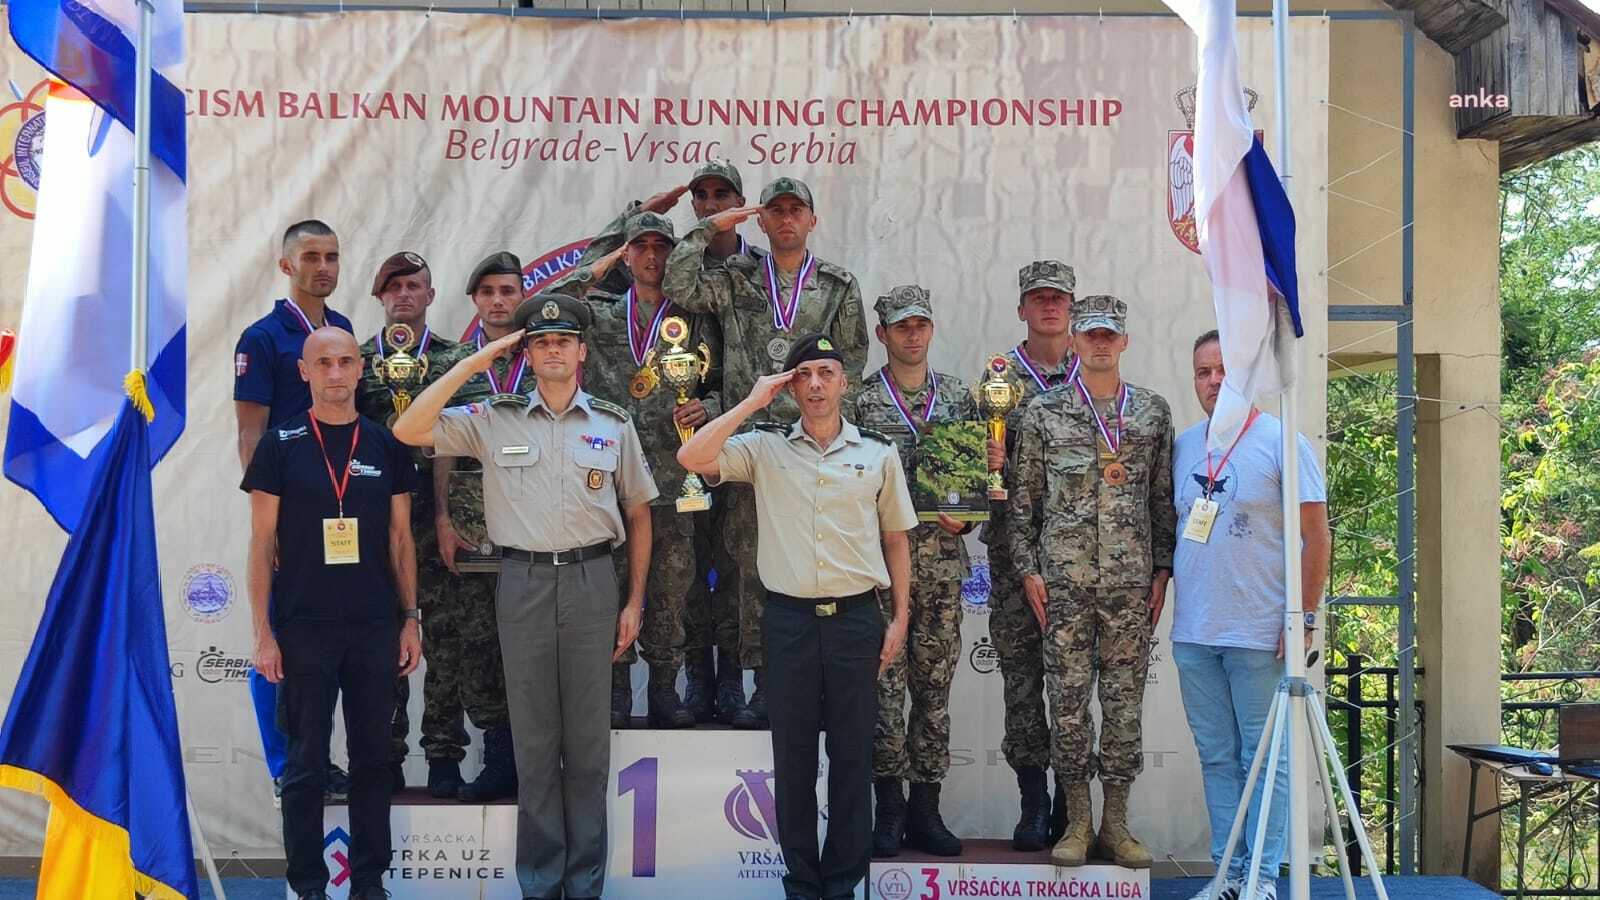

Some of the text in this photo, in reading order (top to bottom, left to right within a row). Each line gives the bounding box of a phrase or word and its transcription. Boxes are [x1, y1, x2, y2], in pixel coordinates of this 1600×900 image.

[278, 91, 426, 120] BALKAN
[441, 94, 640, 125] MOUNTAIN
[653, 98, 825, 127] RUNNING
[836, 98, 1123, 127] CHAMPIONSHIP
[747, 132, 857, 166] Serbia
[522, 247, 587, 290] BALKA
[224, 669, 250, 678] TIM
[617, 756, 658, 878] 1
[461, 849, 491, 861] UZ
[737, 848, 785, 865] VRŠA
[386, 867, 505, 879] TEPENICE
[737, 869, 785, 879] ATLETSK
[920, 867, 1142, 900] 3 VRŠAČKA TRKAČKA LIGA
